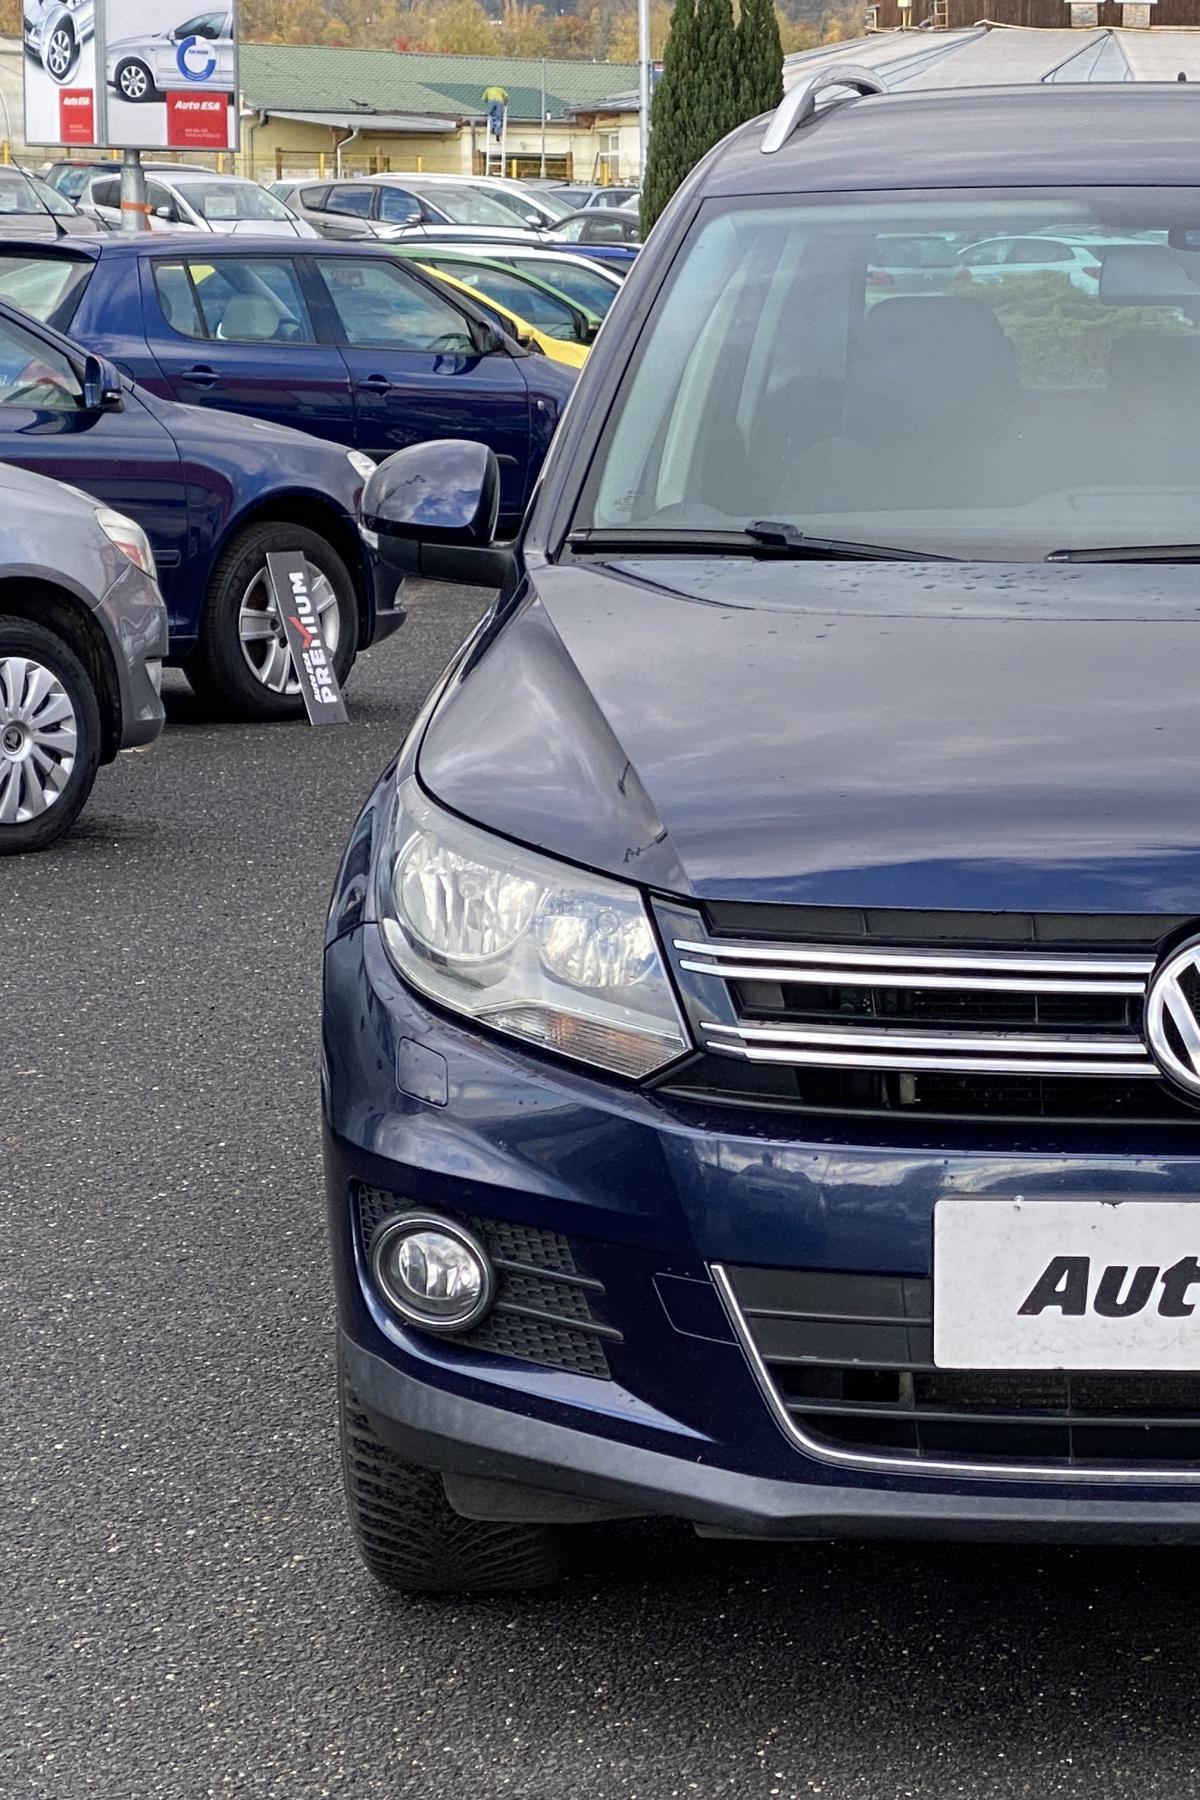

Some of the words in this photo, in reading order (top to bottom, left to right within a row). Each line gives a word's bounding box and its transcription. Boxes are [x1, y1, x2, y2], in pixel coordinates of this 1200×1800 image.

[63, 96, 78, 106] Auto
[174, 100, 200, 110] Auto
[200, 101, 220, 111] ESA
